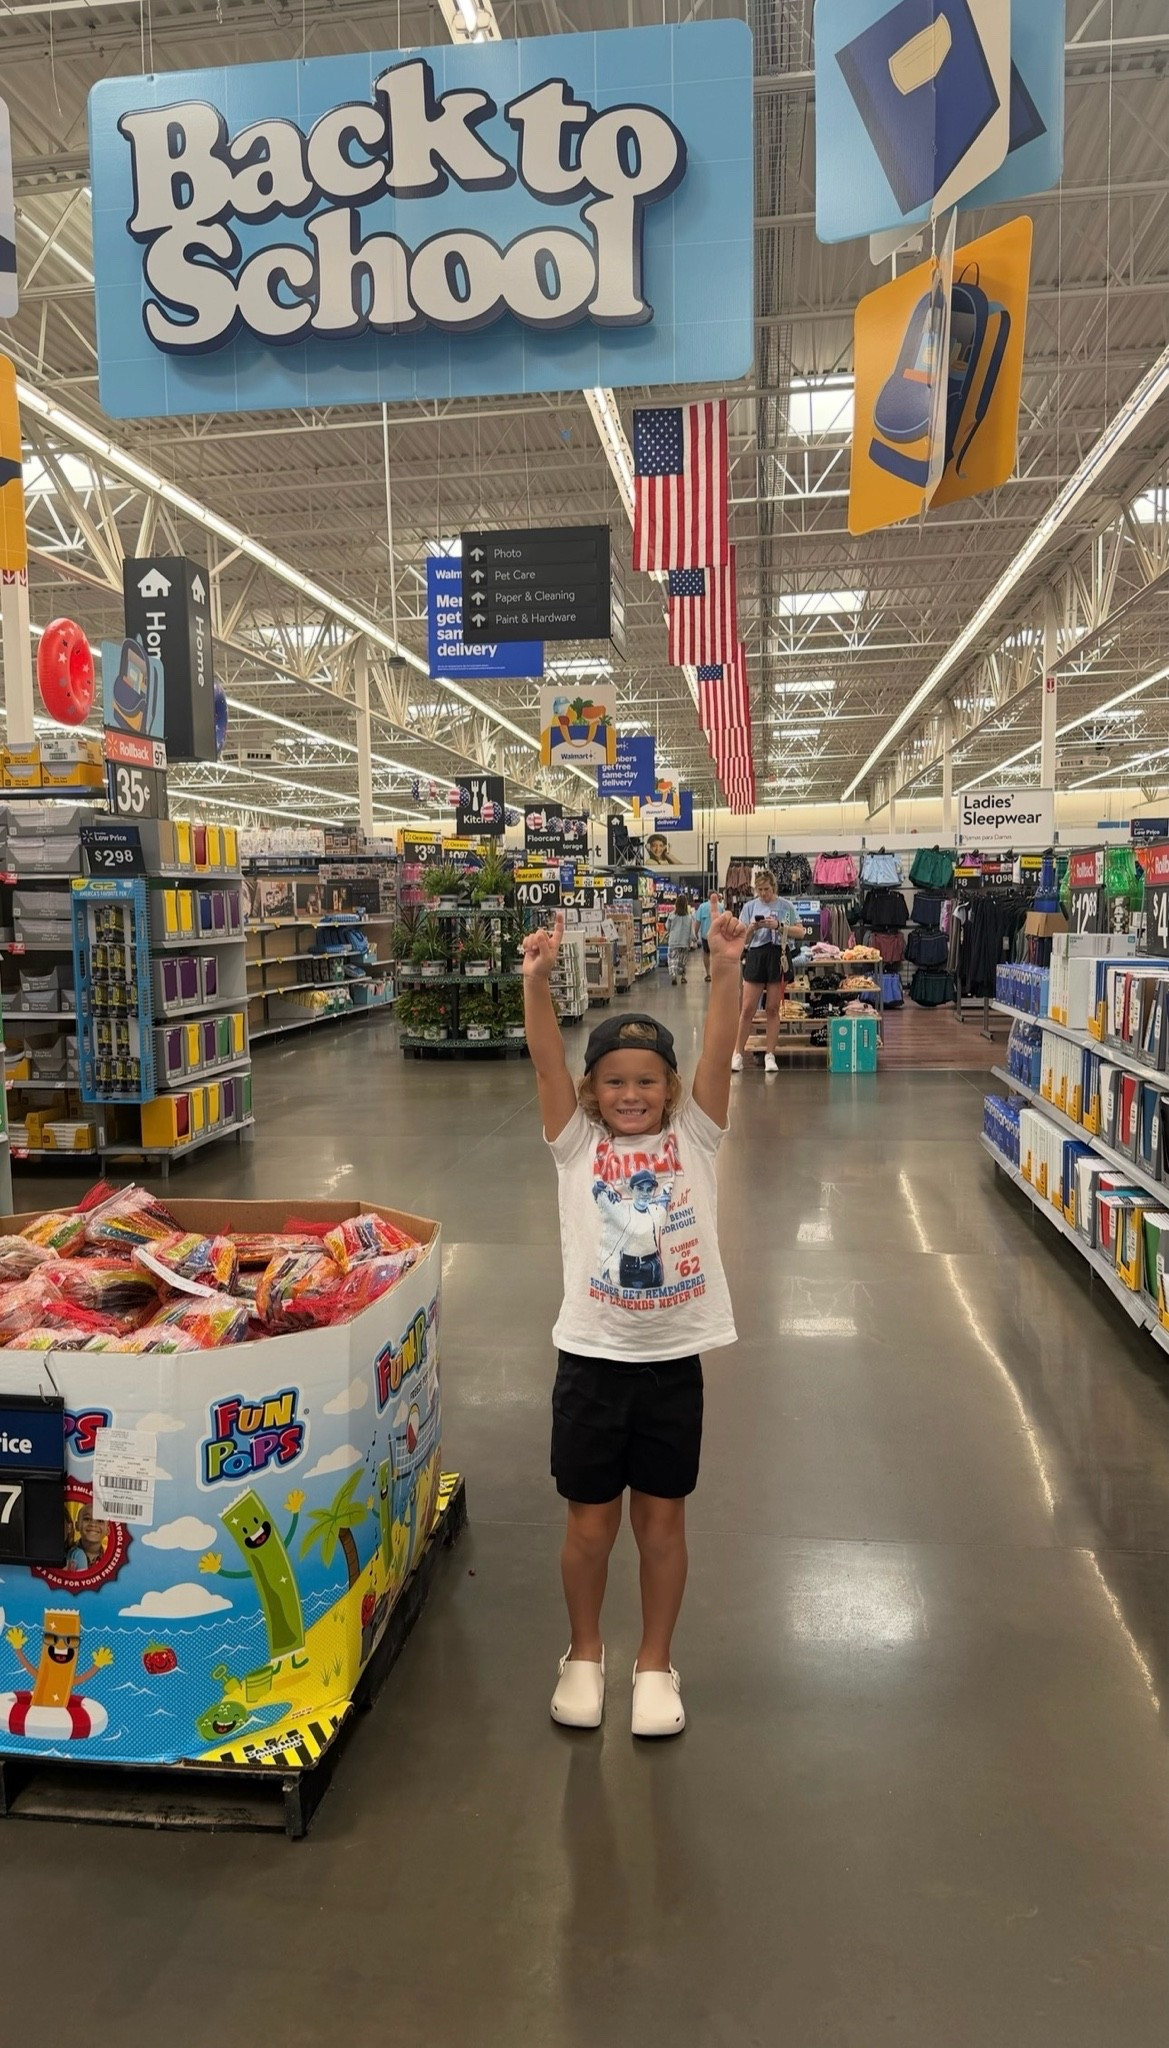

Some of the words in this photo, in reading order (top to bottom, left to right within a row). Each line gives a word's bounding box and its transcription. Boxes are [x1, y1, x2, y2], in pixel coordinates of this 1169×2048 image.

[119, 58, 511, 240] Back
[507, 79, 685, 203] to
[144, 199, 652, 353] School
[494, 548, 522, 559] Photo
[435, 570, 462, 579] Walm
[494, 570, 511, 581] Pet
[513, 569, 536, 580] Care
[495, 592, 522, 605] Paper
[524, 591, 532, 601] &
[534, 589, 576, 603] Cleaning
[436, 611, 462, 627] get
[495, 613, 519, 624] Paint
[521, 613, 529, 623] &
[531, 611, 577, 623] Hardware
[146, 611, 167, 661] Ho
[195, 615, 205, 688] Home
[437, 642, 497, 658] delivery
[119, 741, 150, 761] Rollback
[602, 771, 638, 779] same-day
[602, 779, 633, 787] delivery
[963, 811, 1042, 829] Sleepwear
[527, 834, 561, 842] Floorcare
[562, 843, 583, 851] torage
[90, 882, 117, 891] G2
[669, 1207, 694, 1222] BENNY
[661, 1216, 696, 1235] ODRIGUEZ
[670, 1238, 699, 1254] SUMMER
[681, 1250, 691, 1258] OF
[589, 1288, 606, 1303] BUT
[609, 1296, 655, 1311] LEGENDS
[658, 1291, 691, 1309] NEVER
[693, 1284, 706, 1298] DIE
[622, 1289, 642, 1300] GET
[217, 1393, 294, 1438] FUN
[0, 1432, 32, 1454] ice
[207, 1426, 301, 1480] POPS
[47, 1574, 62, 1585] BAG
[81, 1575, 102, 1586] YOUR
[101, 1548, 122, 1578] FREEZER
